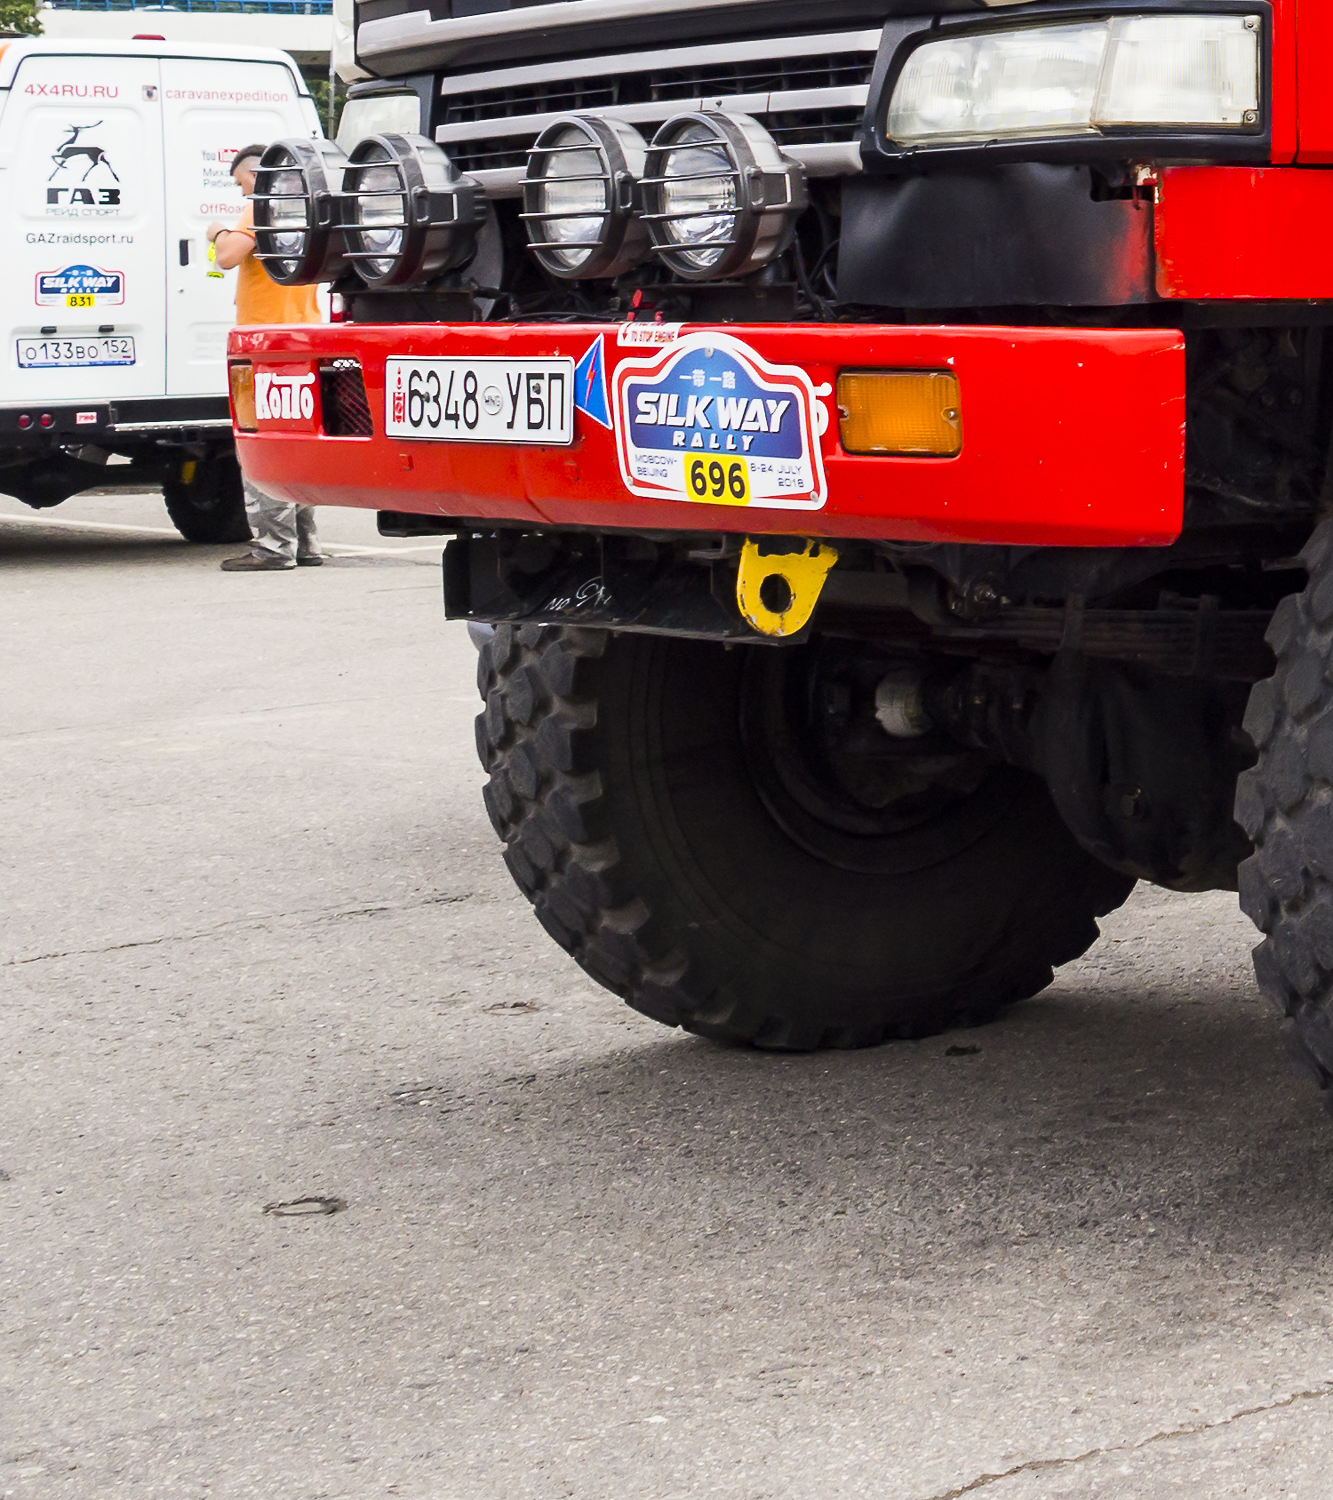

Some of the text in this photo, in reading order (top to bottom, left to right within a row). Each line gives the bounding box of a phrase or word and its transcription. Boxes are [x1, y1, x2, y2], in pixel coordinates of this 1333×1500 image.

[24, 84, 288, 102] 4X4RU.RU caravanexpedition
[46, 188, 121, 205] ГАЗ
[26, 233, 134, 248] GAZraidsport.ru
[42, 276, 117, 288] SILK WAY
[70, 296, 91, 307] 831
[102, 340, 128, 353] 152
[408, 370, 479, 431] 6348
[506, 372, 565, 431] УБП
[635, 391, 713, 429] SILK
[716, 396, 791, 434] WAY
[672, 430, 755, 452] RALLY
[636, 466, 668, 479] BEIJING
[750, 462, 803, 476] 8-24 JULY
[690, 459, 746, 500] 696
